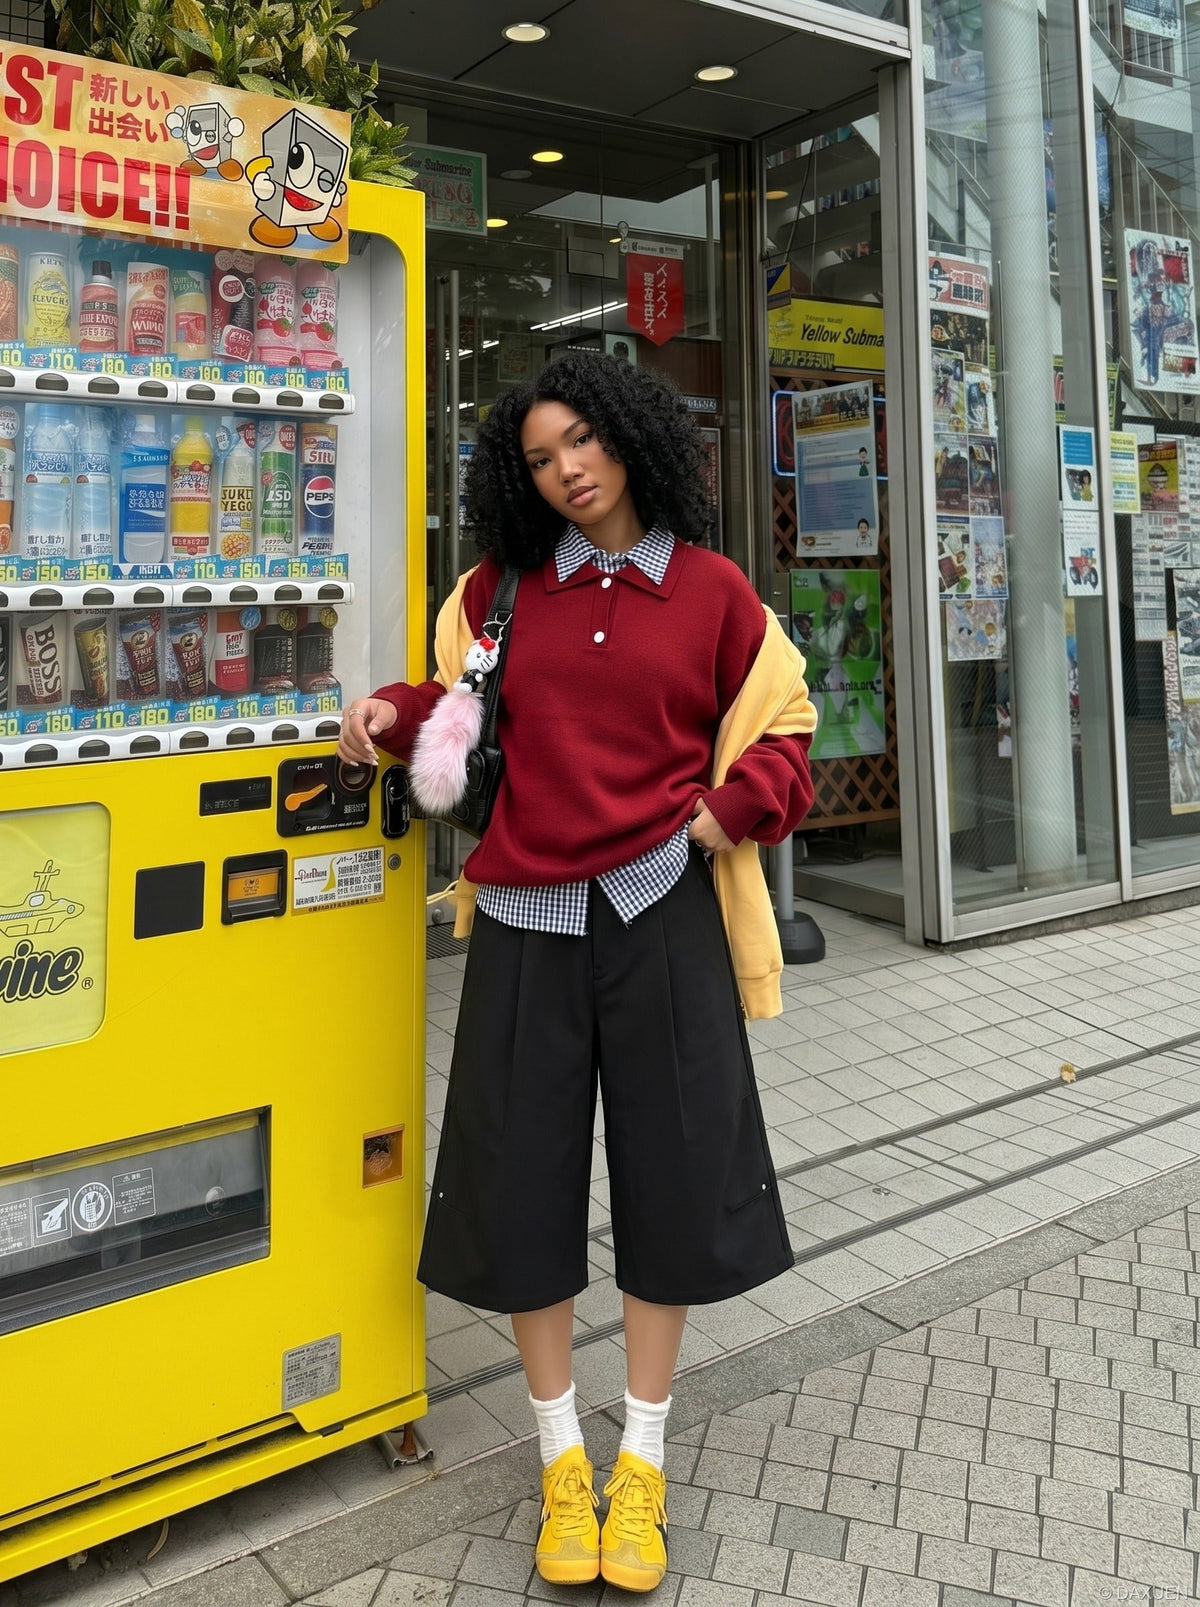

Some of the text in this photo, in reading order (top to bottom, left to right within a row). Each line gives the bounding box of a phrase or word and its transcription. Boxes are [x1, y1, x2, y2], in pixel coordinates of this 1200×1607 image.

[0, 52, 84, 132] ST
[90, 73, 170, 111] 新しい
[88, 107, 169, 143] 出会い
[425, 159, 472, 176] Submarine
[801, 323, 885, 347] Yellow Subma
[49, 353, 75, 370] 110
[36, 565, 61, 581] 150
[80, 564, 109, 580] 150
[194, 563, 217, 579] 110
[239, 563, 261, 578] 150
[287, 562, 308, 578] 150
[324, 562, 344, 578] 150
[35, 624, 62, 694] BOSS
[274, 700, 296, 716] 150
[317, 696, 338, 712] 160
[95, 711, 124, 729] 110
[188, 705, 216, 722] 180
[45, 714, 71, 733] 160
